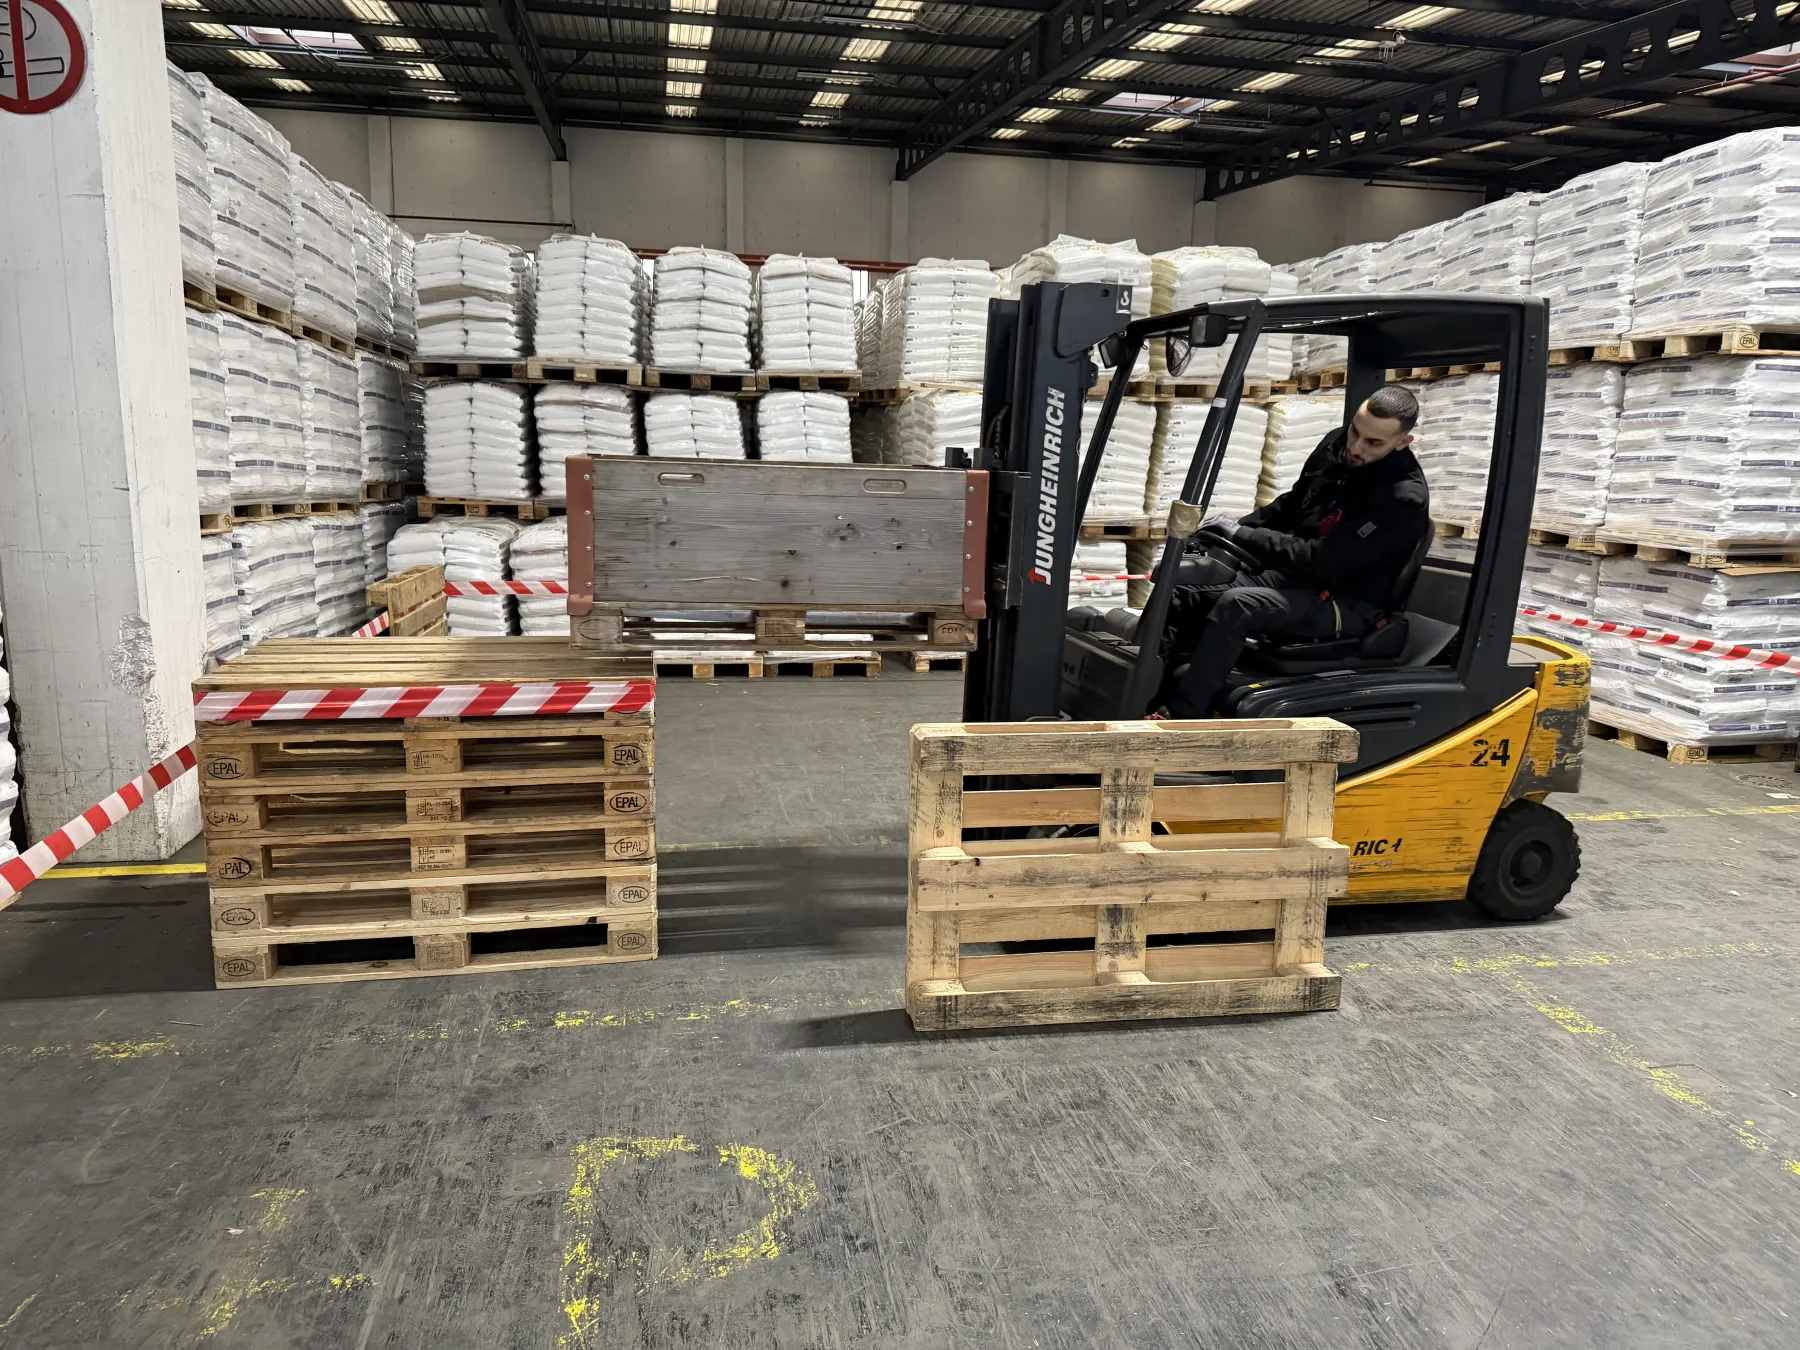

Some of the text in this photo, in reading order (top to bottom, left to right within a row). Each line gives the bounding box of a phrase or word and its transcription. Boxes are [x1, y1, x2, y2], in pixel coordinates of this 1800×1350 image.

[1028, 387, 1065, 585] JUNGHEINRICH
[614, 749, 639, 763] EPAL
[1470, 739, 1510, 767] 24
[212, 762, 242, 775] EPAL
[615, 796, 642, 809] EPAL
[213, 811, 244, 824] EPAL
[619, 840, 647, 853] EPAL
[622, 889, 646, 900] EPAL
[620, 936, 644, 947] EPAL
[226, 962, 252, 973] EPAL
